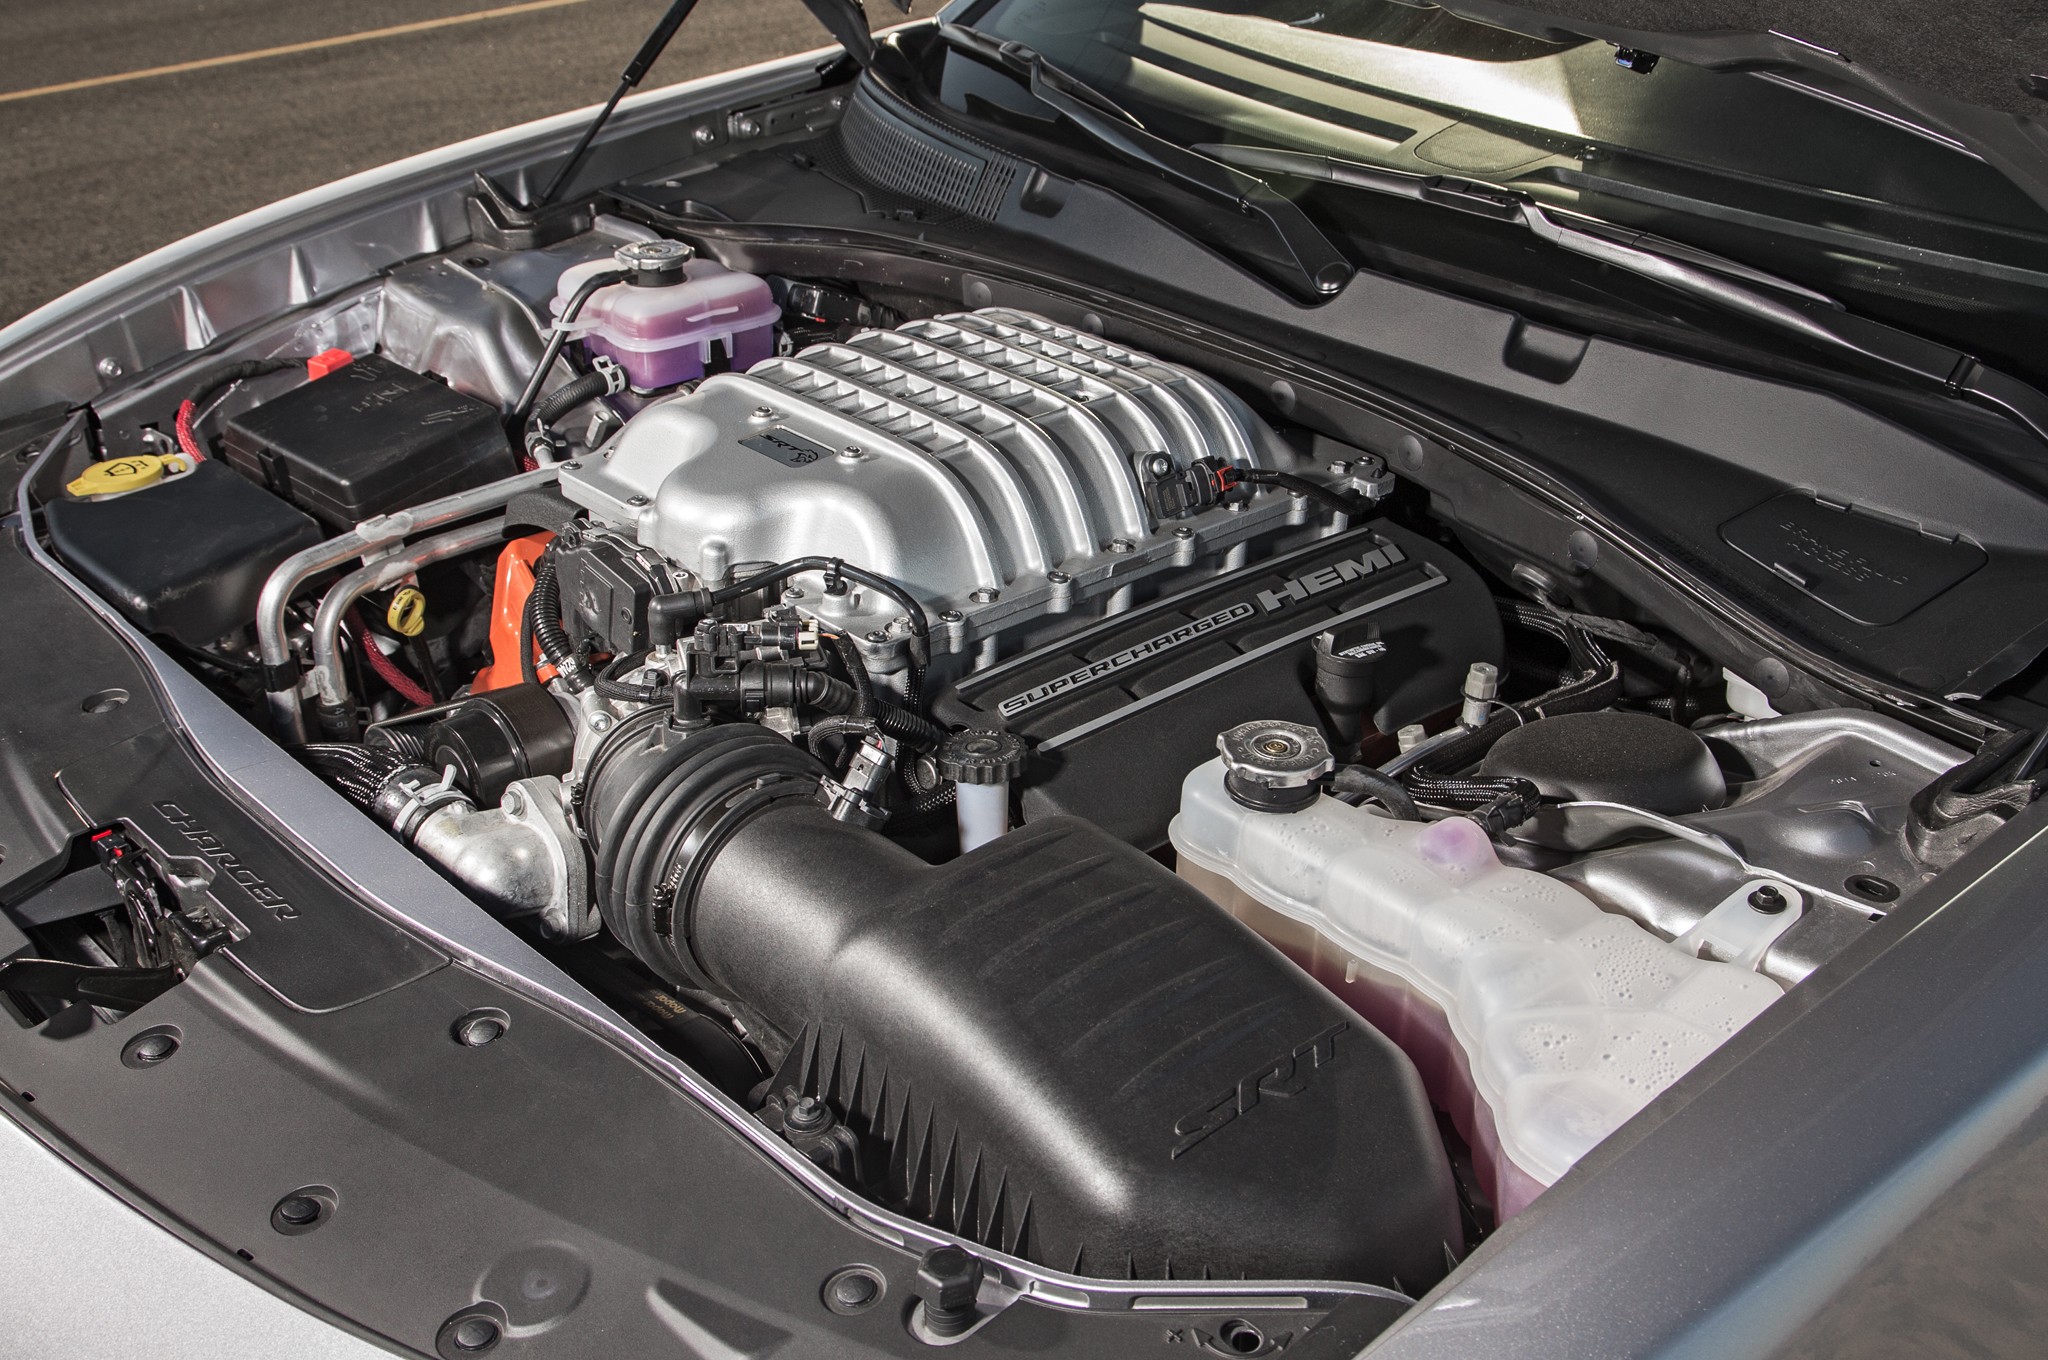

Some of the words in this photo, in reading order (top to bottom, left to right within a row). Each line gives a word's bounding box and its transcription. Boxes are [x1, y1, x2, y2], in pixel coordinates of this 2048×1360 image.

[758, 434, 805, 453] SRT
[1002, 603, 1250, 715] SUPERCHARGED
[1256, 543, 1407, 614] HEMI
[151, 799, 303, 922] CHARGER
[1170, 1021, 1350, 1160] SRT
